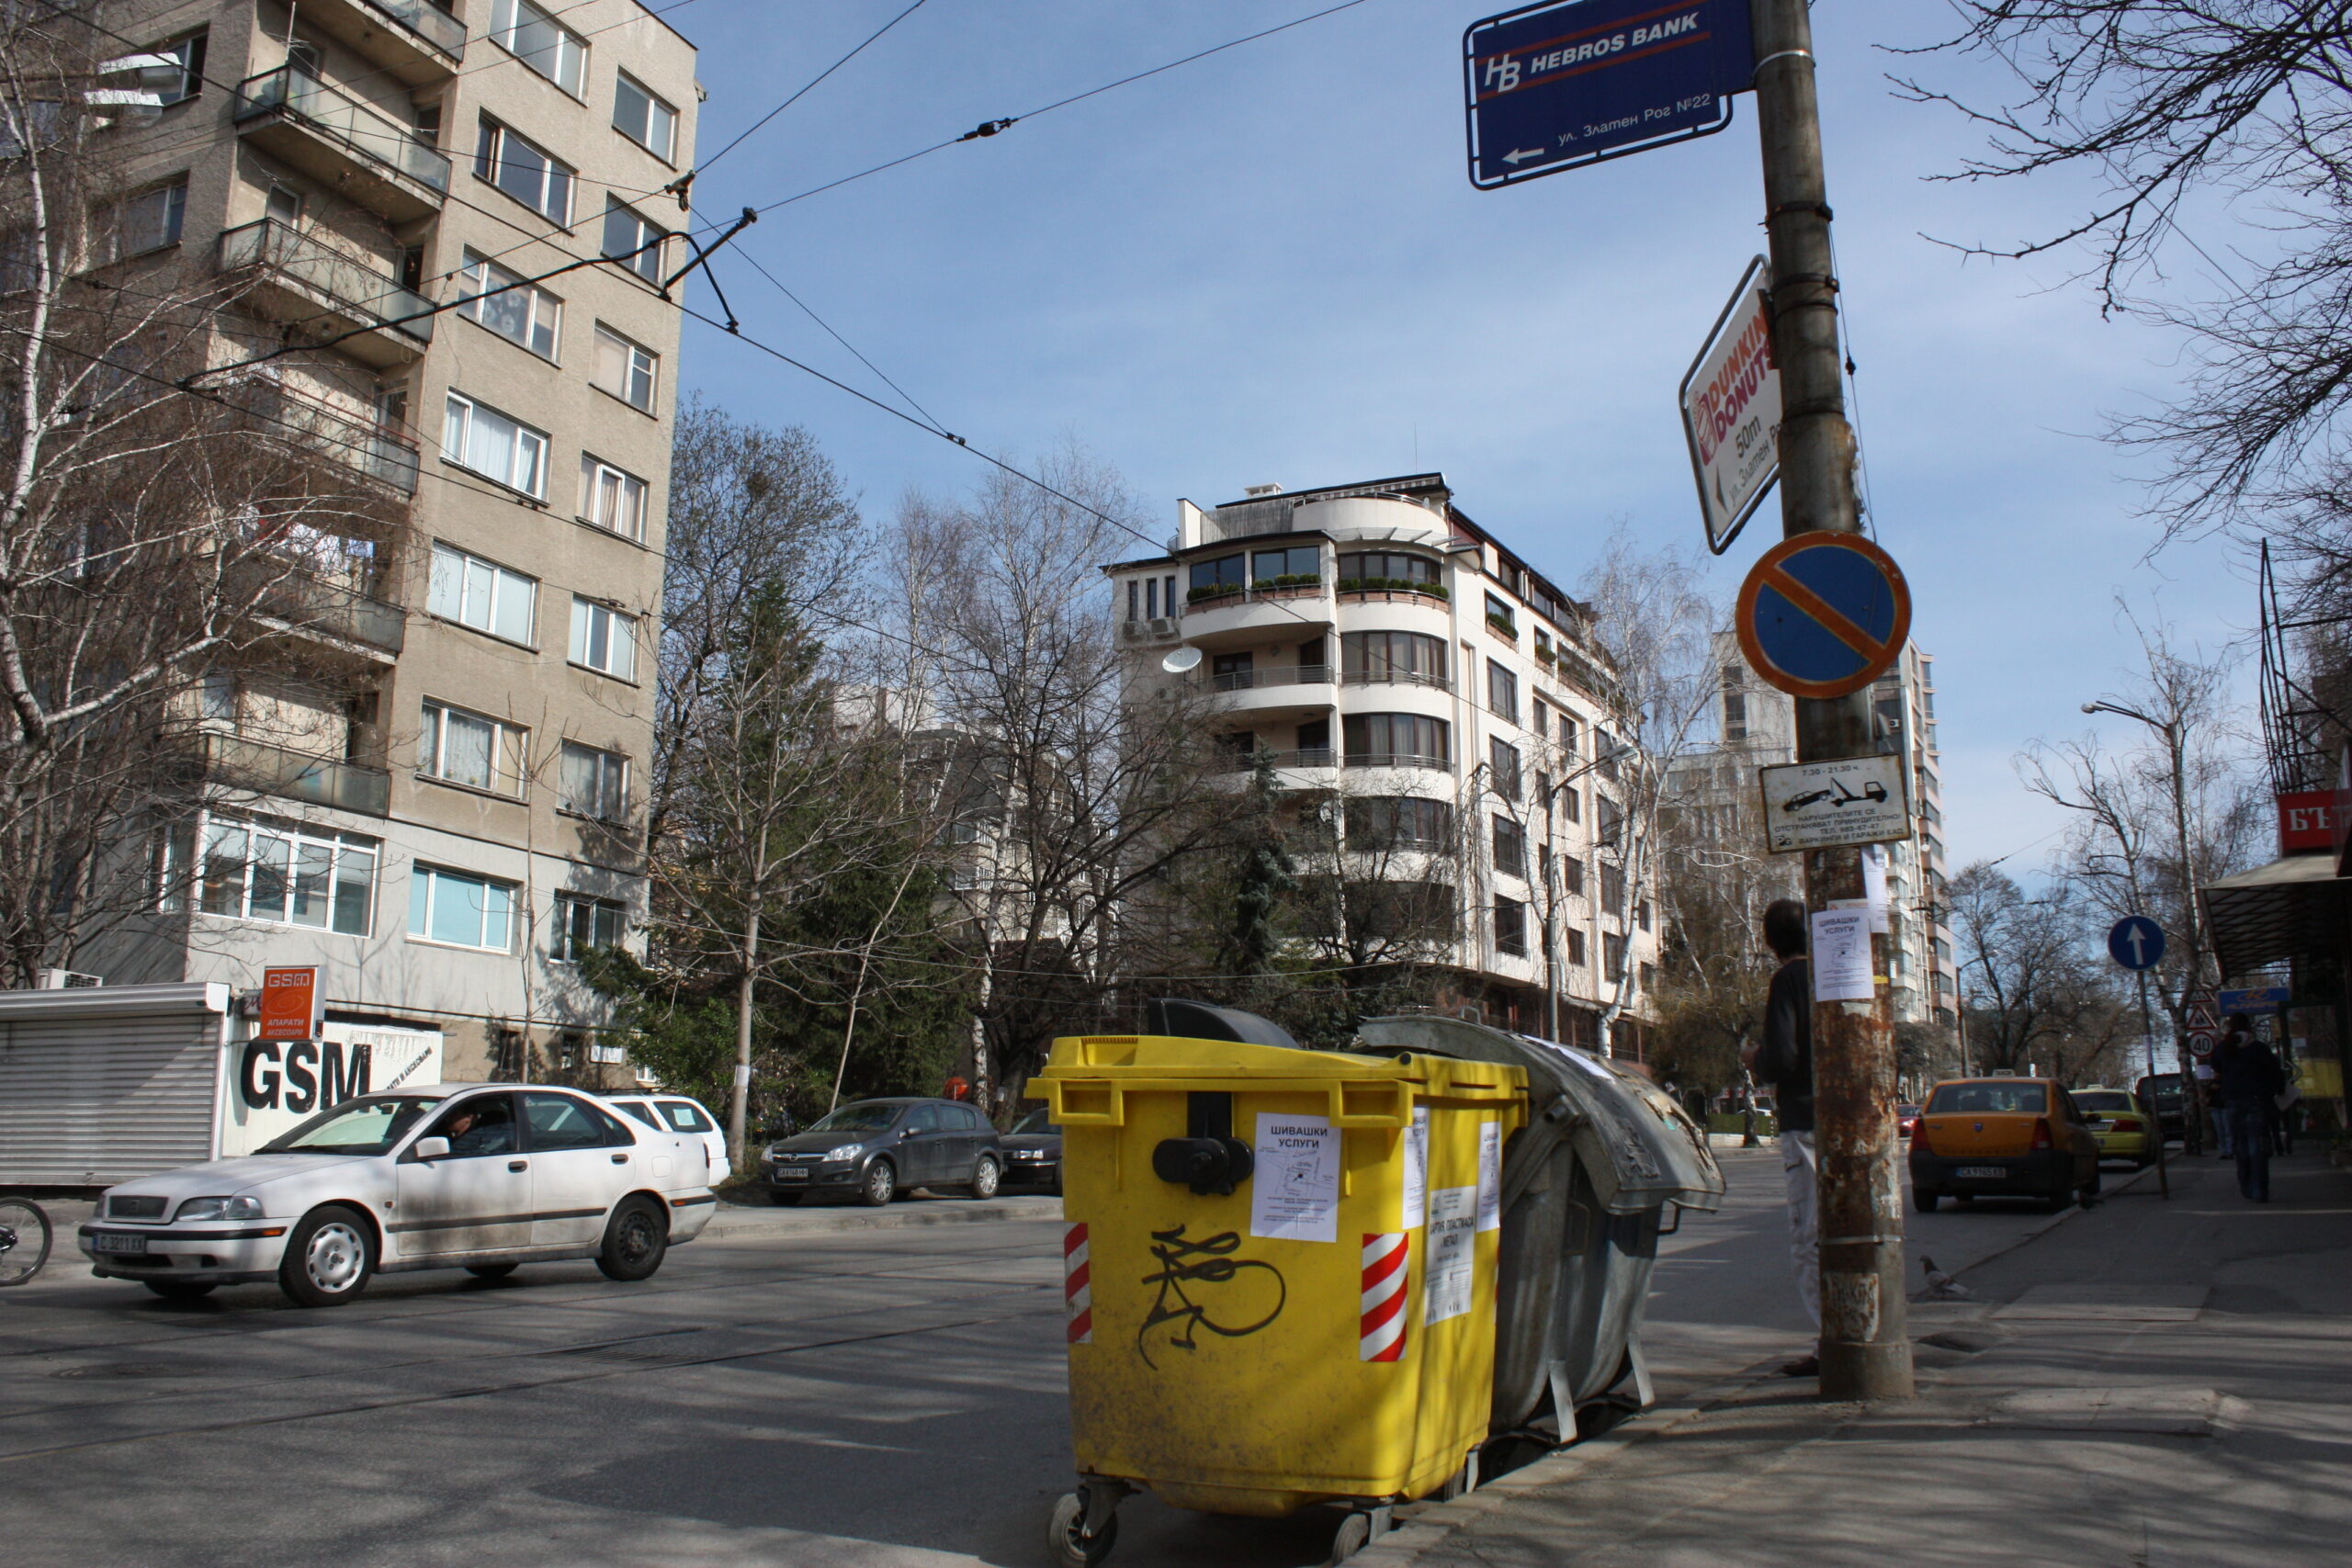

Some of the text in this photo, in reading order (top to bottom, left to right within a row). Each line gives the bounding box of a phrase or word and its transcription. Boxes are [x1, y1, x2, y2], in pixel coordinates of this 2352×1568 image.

[1531, 34, 1625, 74] HEBROS
[1631, 11, 1700, 47] BANK
[1558, 94, 1712, 146] ул. Златен Рог №22
[1736, 415, 1761, 458] 50m
[1740, 442, 1770, 488] Златен
[1803, 768, 1821, 777] 7.30
[1827, 765, 1850, 774] 21.30
[2287, 806, 2351, 831] БЪ
[1850, 829, 1884, 840] ГАРАЖИ
[268, 973, 310, 987] GSM
[266, 1019, 305, 1027] АПАРАТИ
[2193, 1038, 2211, 1052] 40
[241, 1041, 372, 1114] GSM
[1271, 1125, 1328, 1136] ШИВАШКИ
[1279, 1138, 1319, 1148] УСЛУГИ
